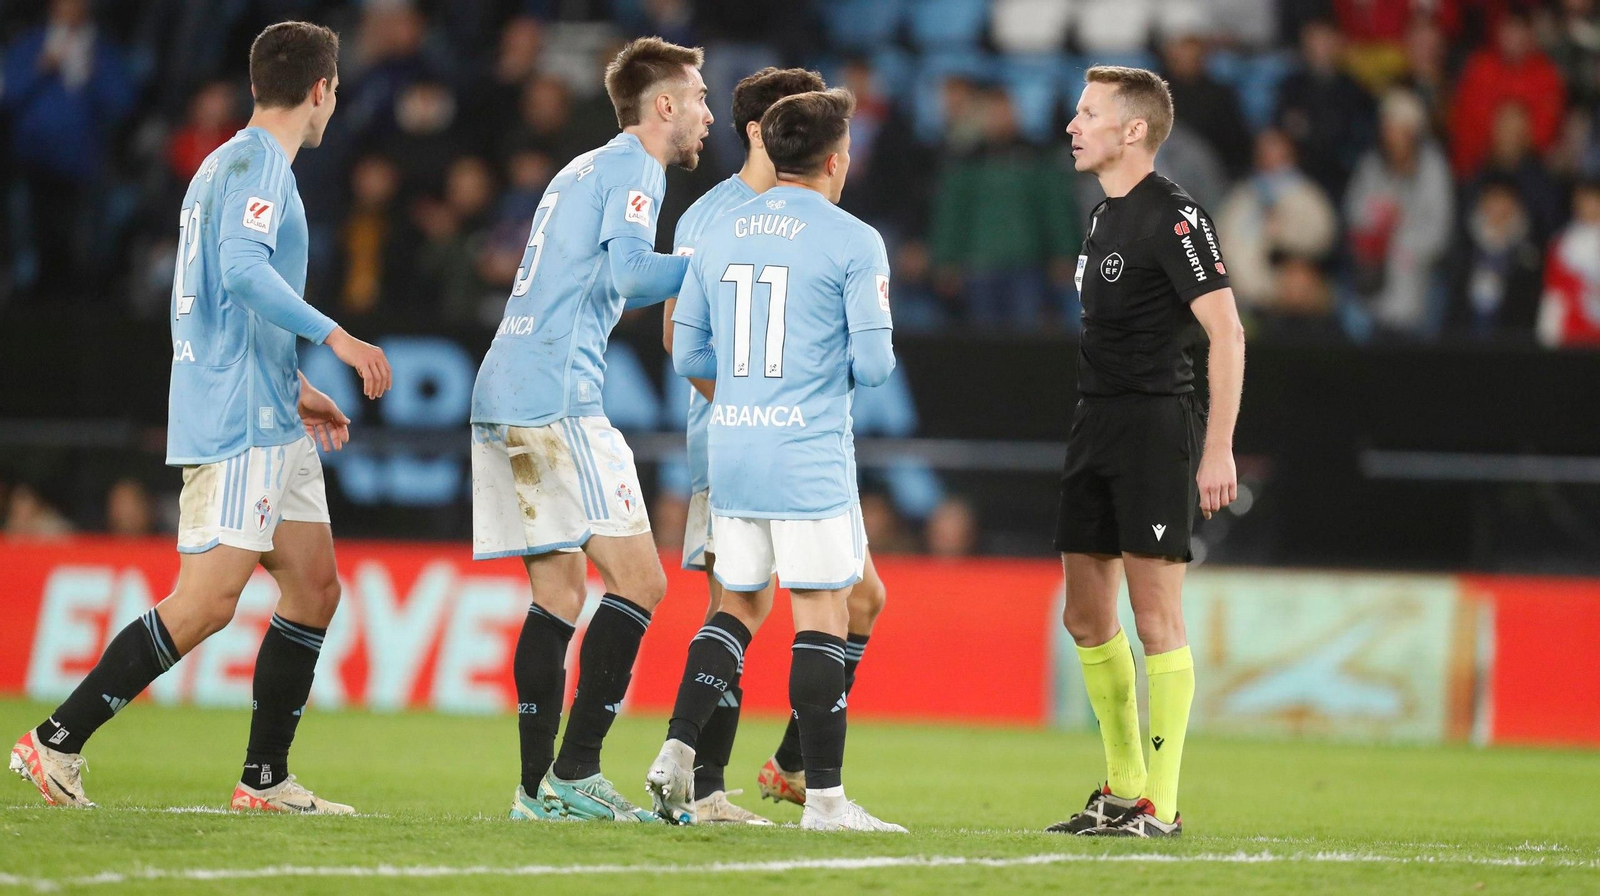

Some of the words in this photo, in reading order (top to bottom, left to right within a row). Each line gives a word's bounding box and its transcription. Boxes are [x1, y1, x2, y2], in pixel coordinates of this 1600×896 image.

[246, 218, 267, 229] LALIGA
[734, 213, 808, 241] CHUKY
[175, 200, 202, 321] 12
[512, 190, 560, 297] 3
[1181, 235, 1207, 282] WÜRTH
[498, 315, 535, 335] ANCA
[720, 263, 789, 378] 11
[709, 404, 806, 428] ABANCA
[599, 431, 627, 472] 3
[24, 560, 642, 708] EEYE
[695, 672, 728, 692] 2023
[517, 702, 537, 714] 23
